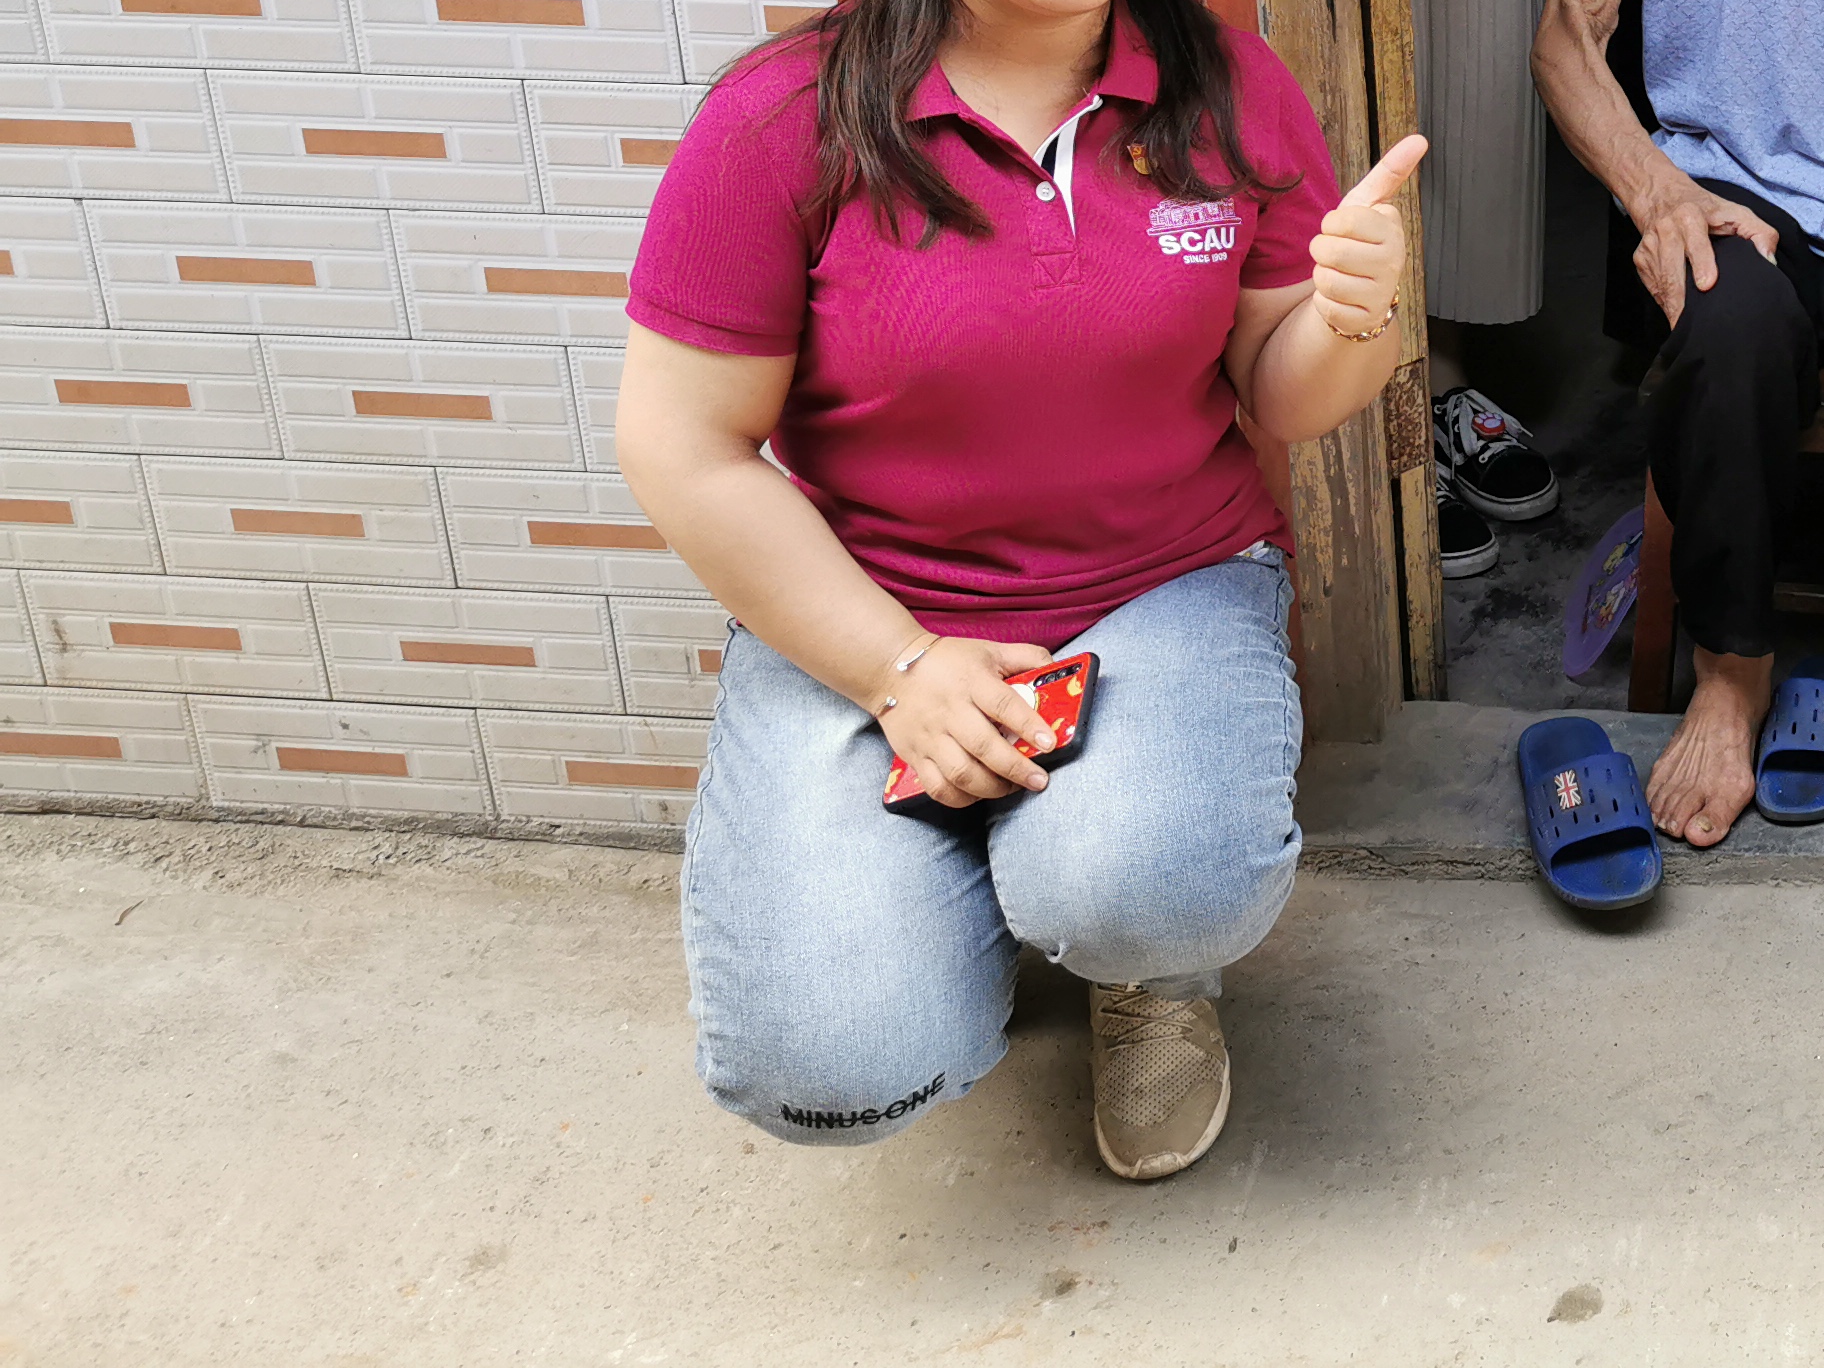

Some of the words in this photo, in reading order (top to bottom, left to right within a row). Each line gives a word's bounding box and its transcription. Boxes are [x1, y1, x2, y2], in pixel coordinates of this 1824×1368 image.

[1158, 226, 1236, 255] SCAU
[1183, 254, 1210, 264] SINCE
[1212, 252, 1228, 263] 1909
